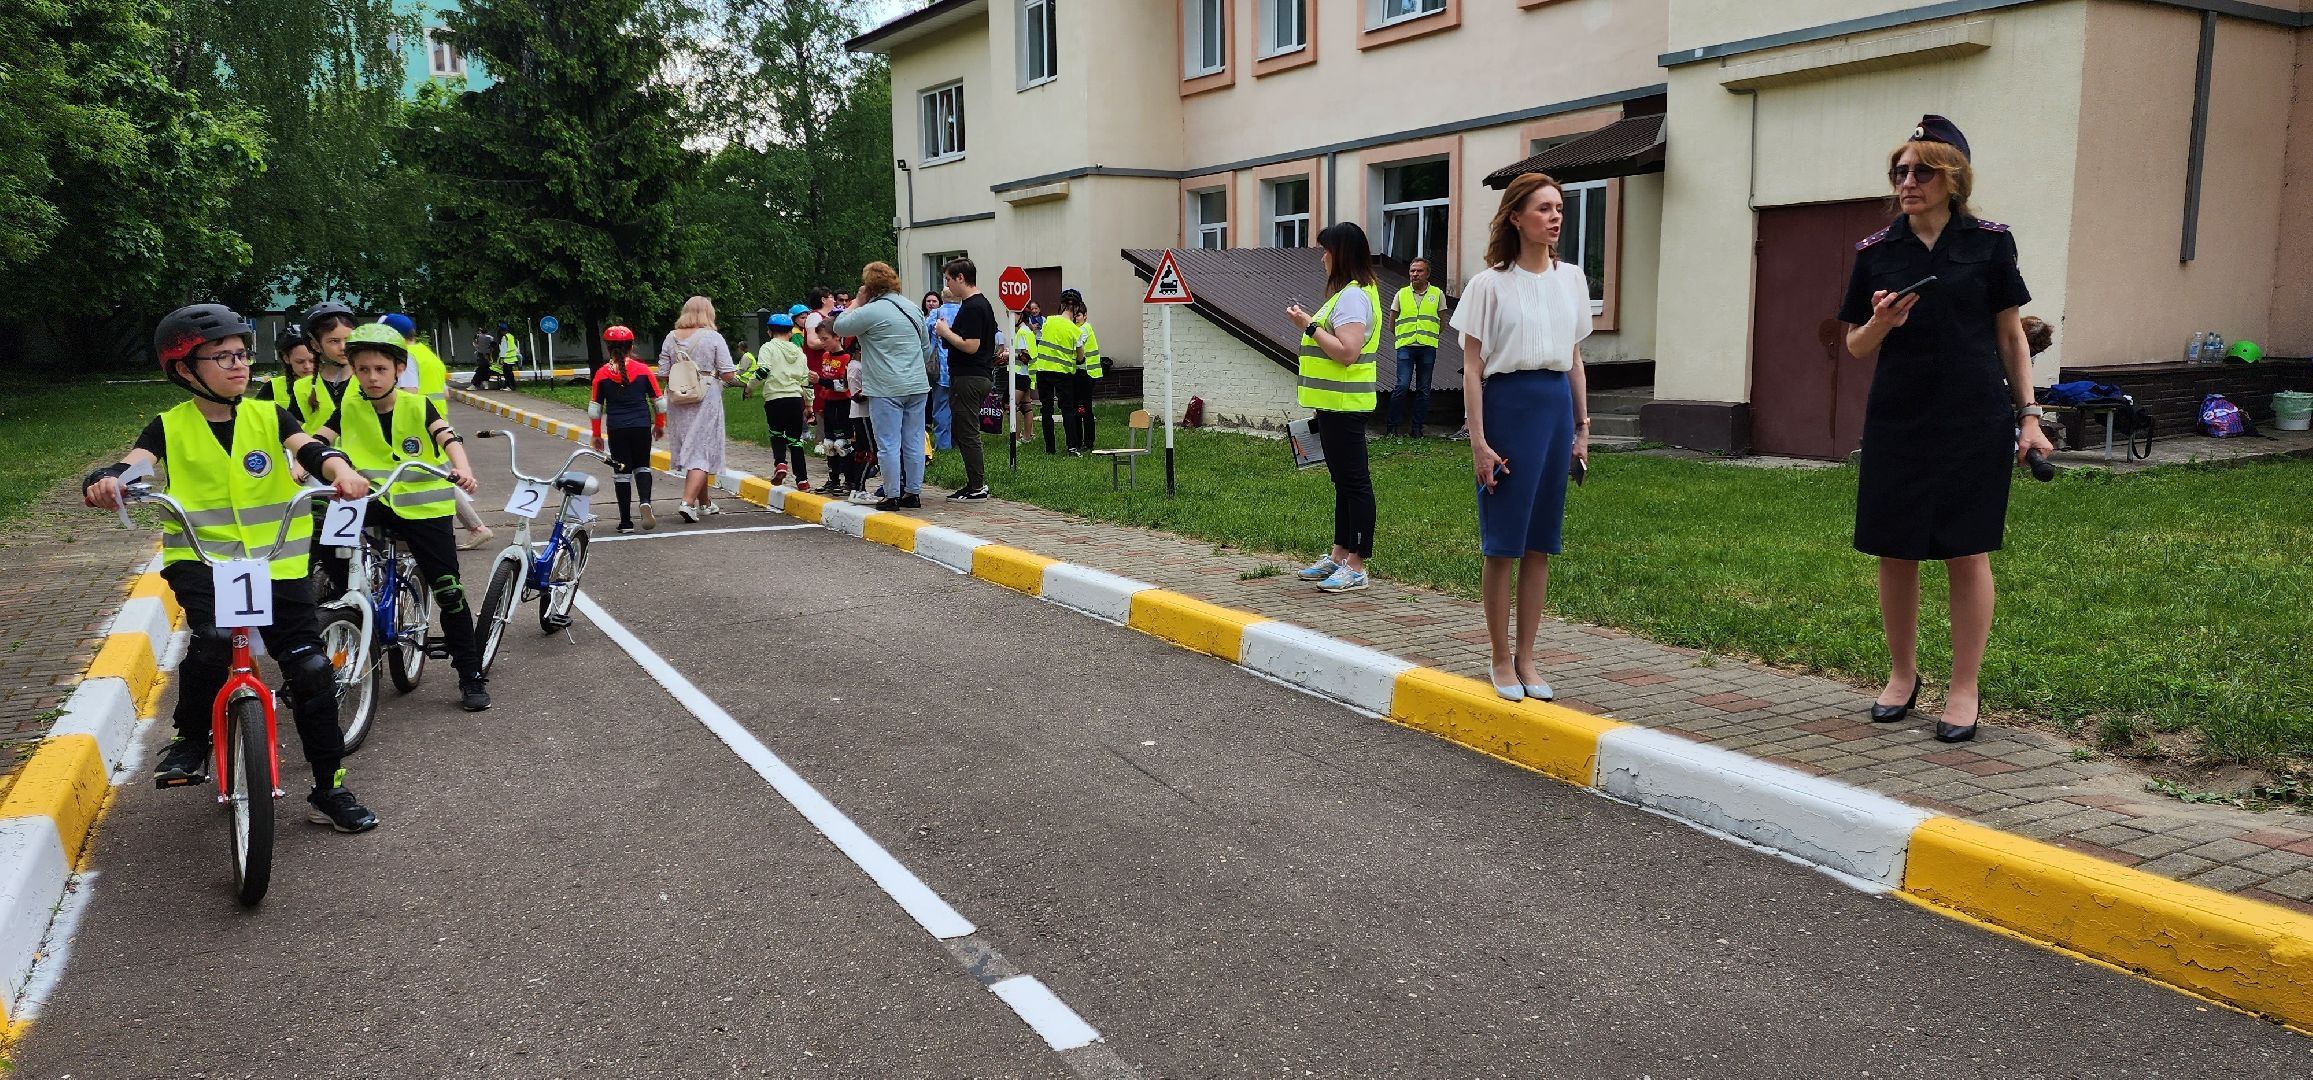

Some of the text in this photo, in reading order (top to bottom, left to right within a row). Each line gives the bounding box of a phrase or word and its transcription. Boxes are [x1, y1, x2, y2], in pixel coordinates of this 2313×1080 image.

[1001, 281, 1028, 296] STOP
[516, 489, 539, 513] 2
[333, 506, 358, 538] 2
[232, 572, 265, 616] 1
